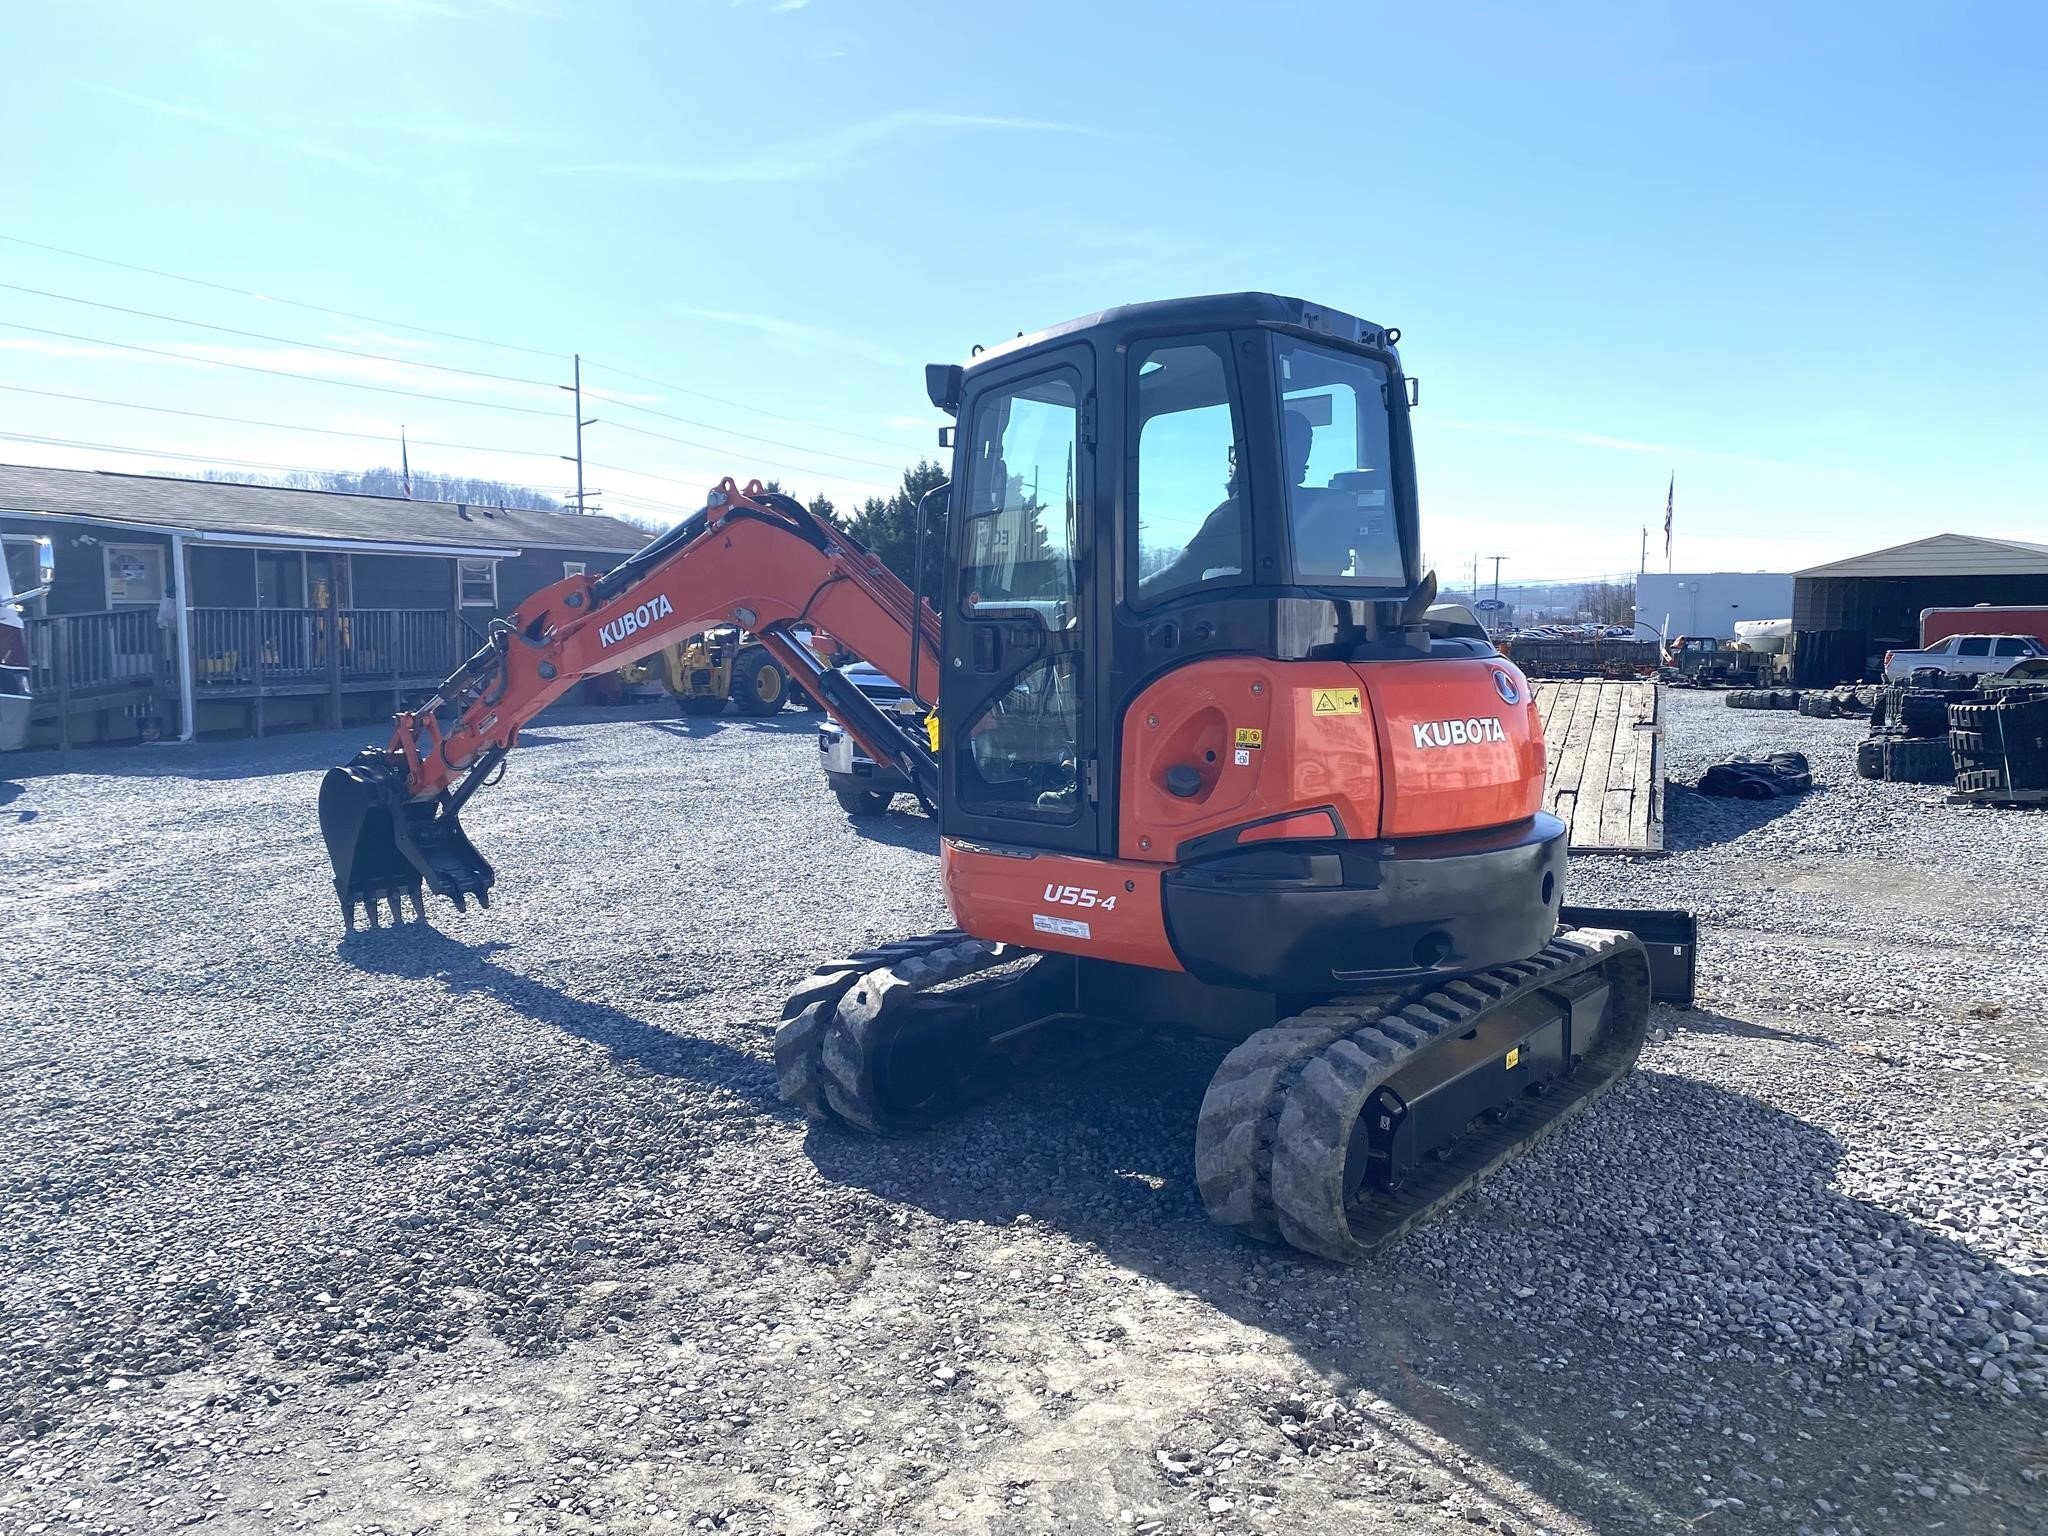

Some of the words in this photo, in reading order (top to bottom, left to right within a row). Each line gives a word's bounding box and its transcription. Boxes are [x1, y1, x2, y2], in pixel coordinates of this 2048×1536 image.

[598, 593, 674, 648] KUBOTA
[1412, 718, 1506, 748] KUBOTA
[1043, 883, 1117, 911] U55-4
